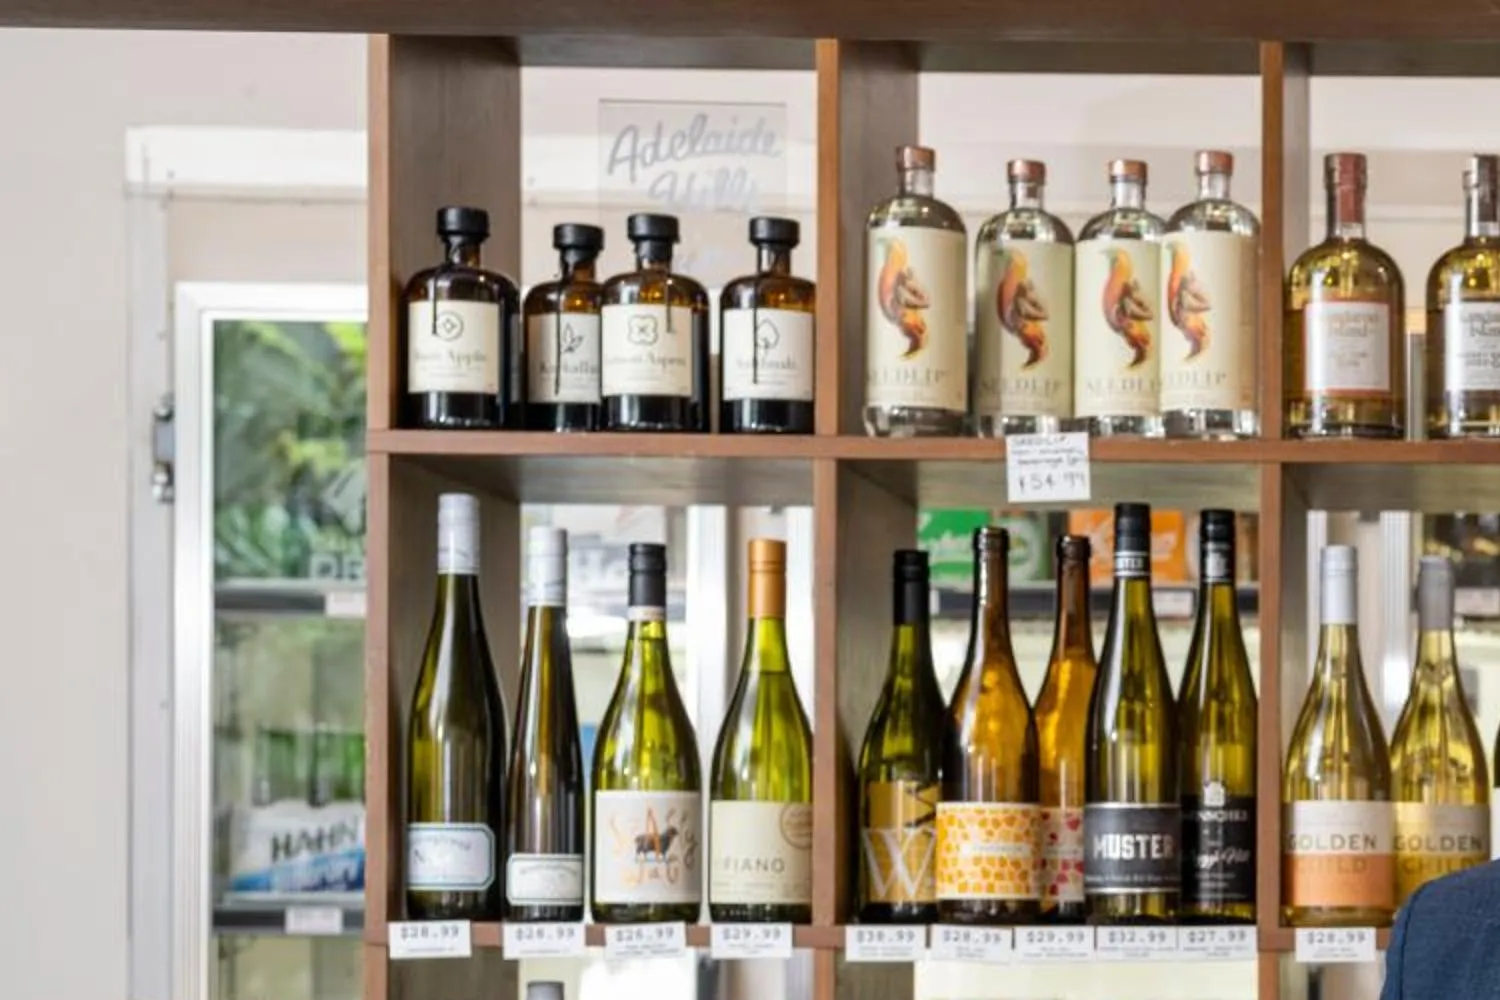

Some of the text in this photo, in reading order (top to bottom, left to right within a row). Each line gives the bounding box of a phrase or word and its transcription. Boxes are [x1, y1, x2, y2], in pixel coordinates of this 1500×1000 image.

[608, 113, 783, 183] Adelaide
[1092, 833, 1175, 861] MUSTER
[1289, 833, 1377, 851] GOLDEN
[1394, 833, 1482, 851] GOLDEN
[722, 858, 786, 873] FIANO
